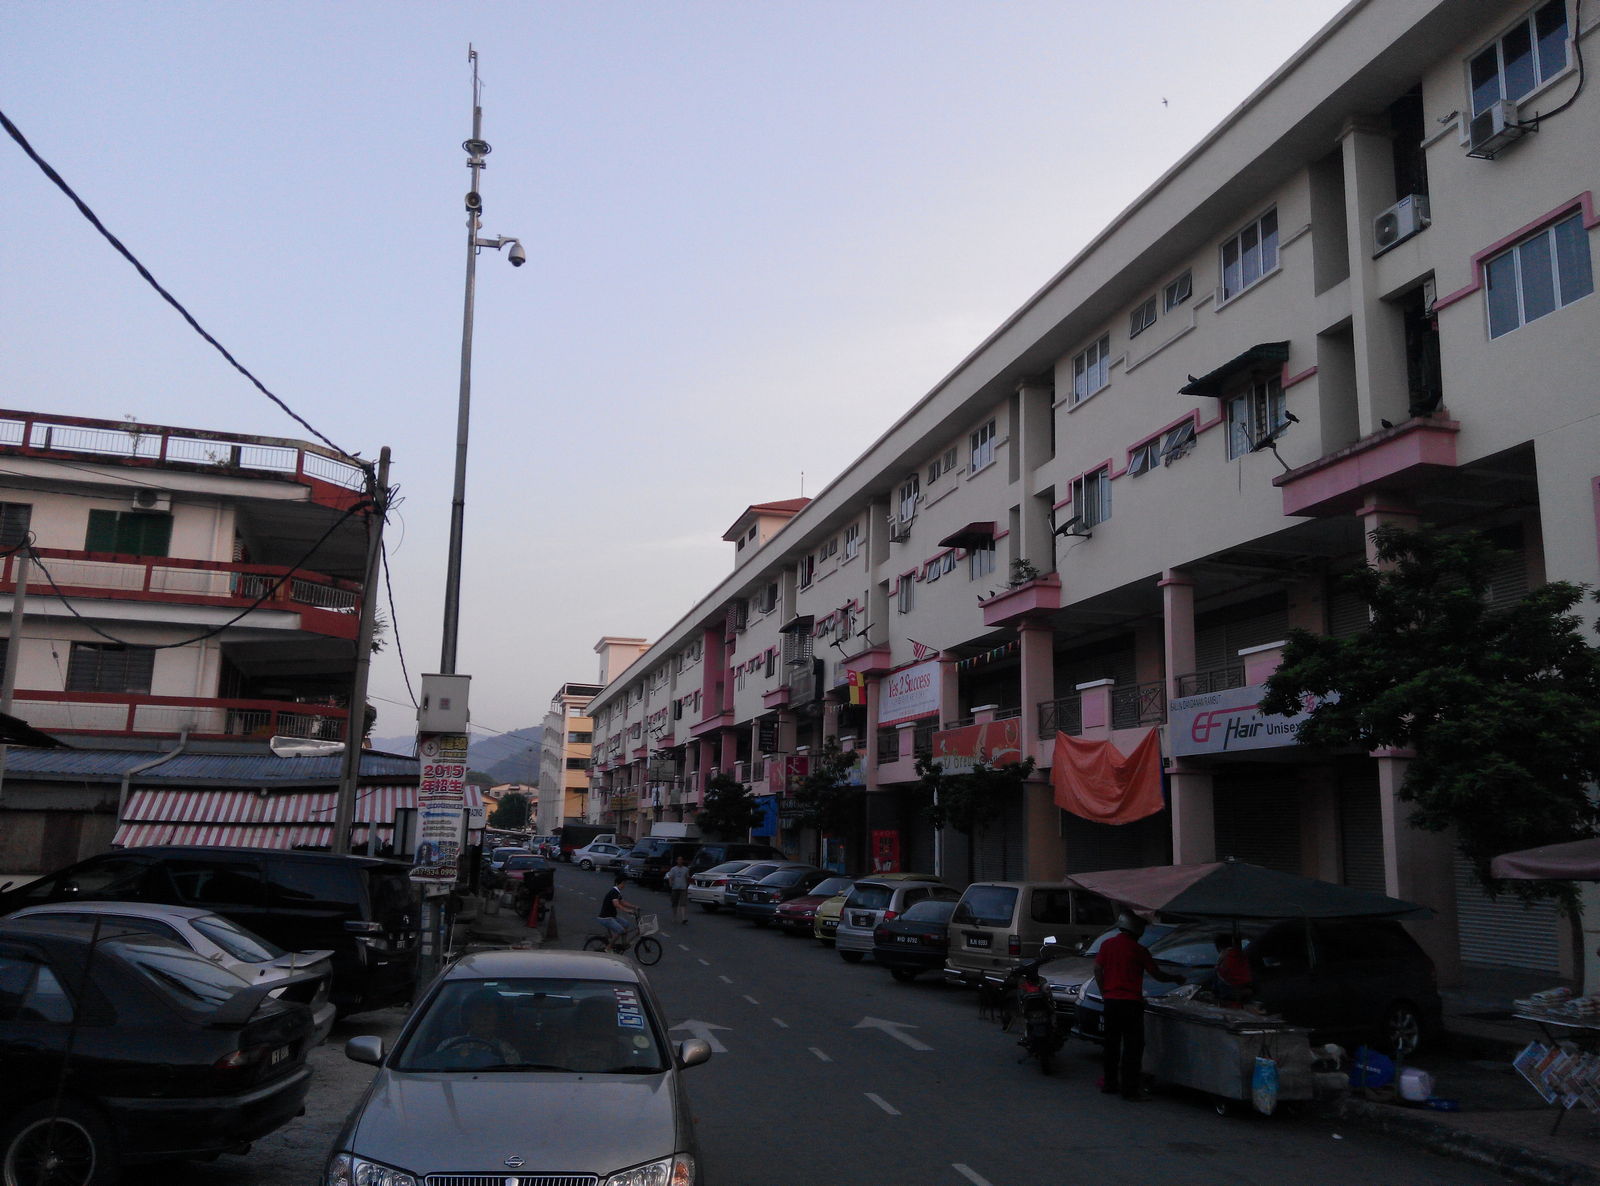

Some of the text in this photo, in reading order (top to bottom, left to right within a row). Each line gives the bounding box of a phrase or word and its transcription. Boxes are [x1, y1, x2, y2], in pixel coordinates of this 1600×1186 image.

[888, 679, 898, 698] Yes
[899, 676, 904, 695] 2
[905, 673, 931, 693] Success
[1223, 714, 1264, 750] Hair
[1266, 721, 1302, 736] Unisex
[423, 764, 465, 779] 2015
[421, 779, 464, 795] 年招生
